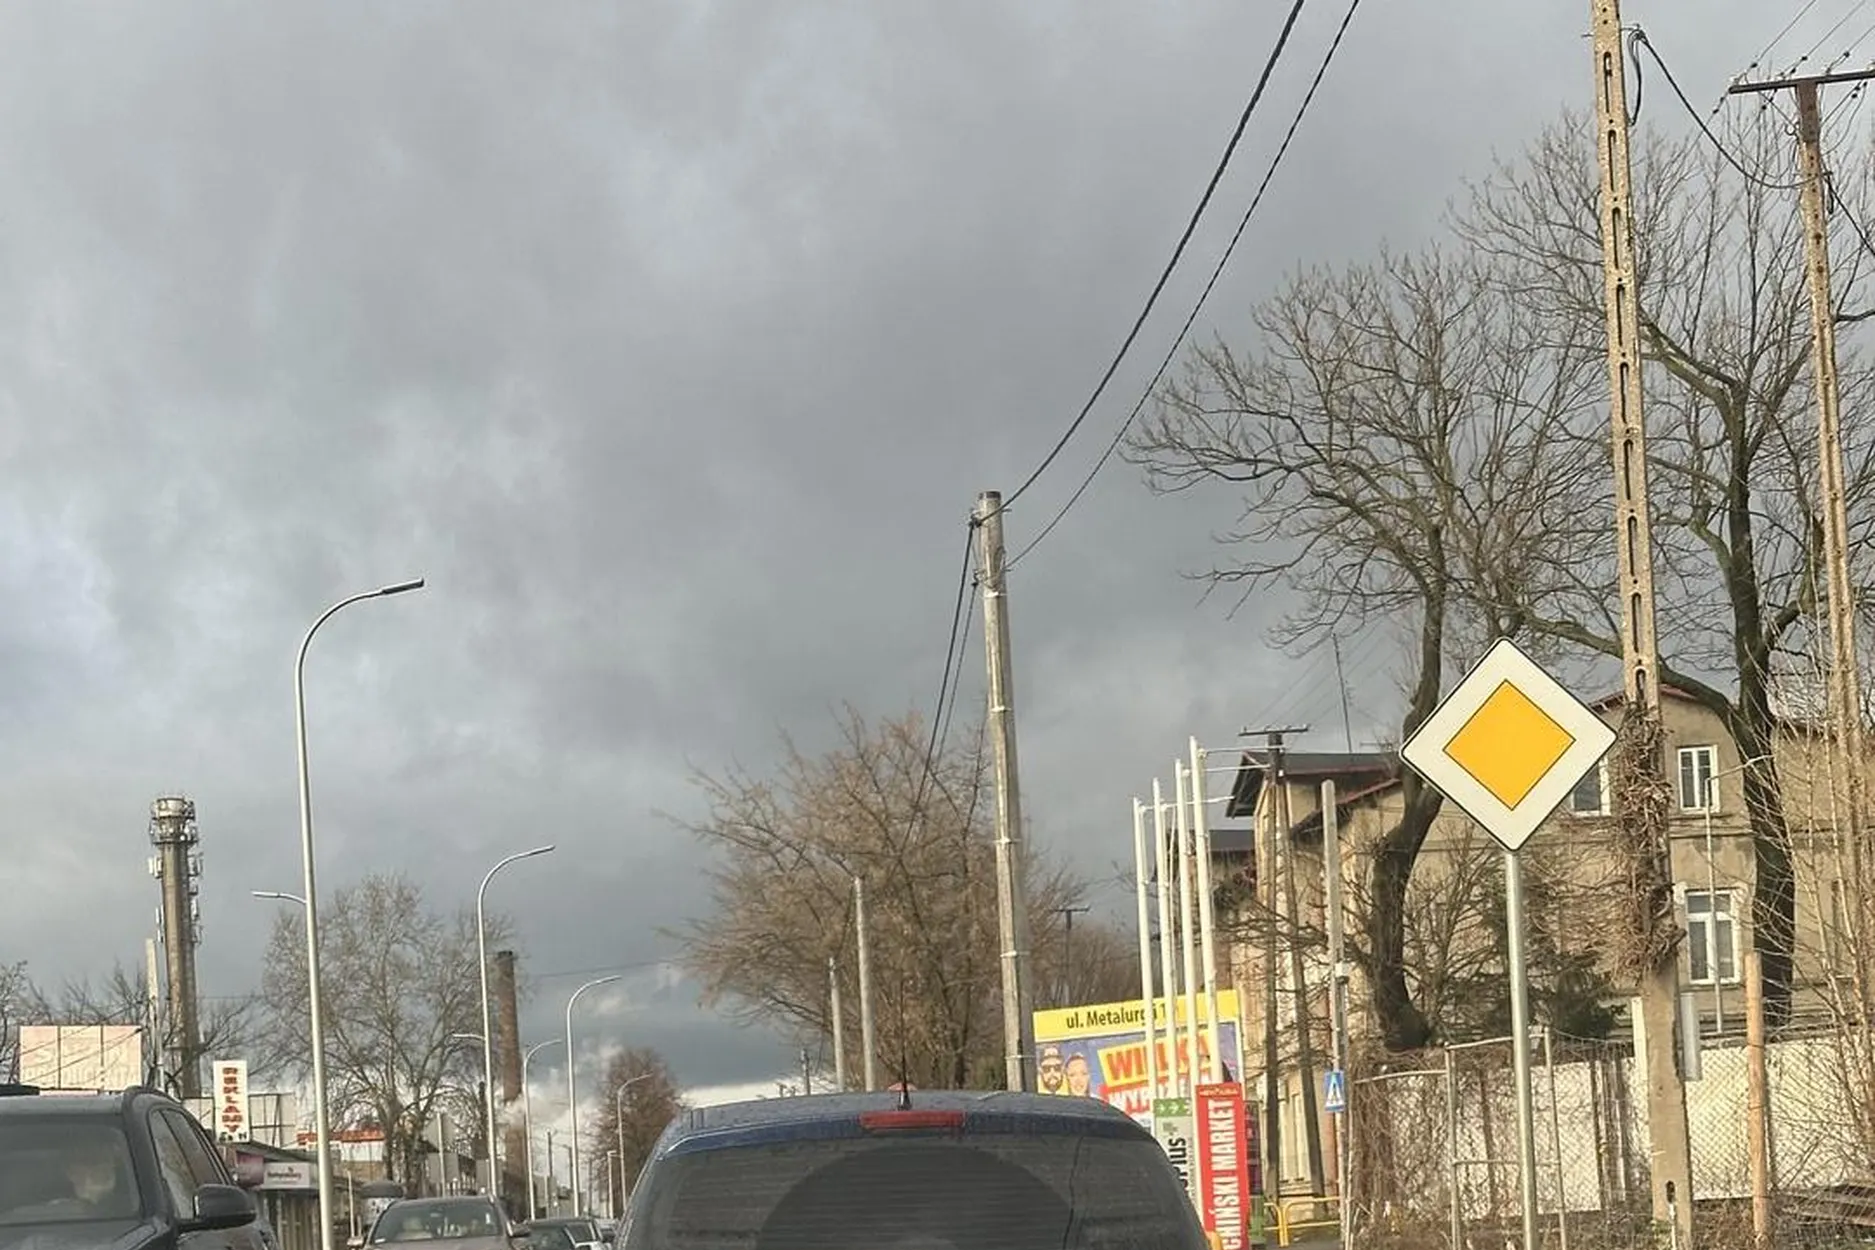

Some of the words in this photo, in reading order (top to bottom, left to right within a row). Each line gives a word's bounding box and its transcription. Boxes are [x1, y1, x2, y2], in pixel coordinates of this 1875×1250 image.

[1066, 1012, 1084, 1029] ul.
[1207, 1099, 1237, 1171] MARKET
[1209, 1176, 1242, 1250] CHIŃSKI
